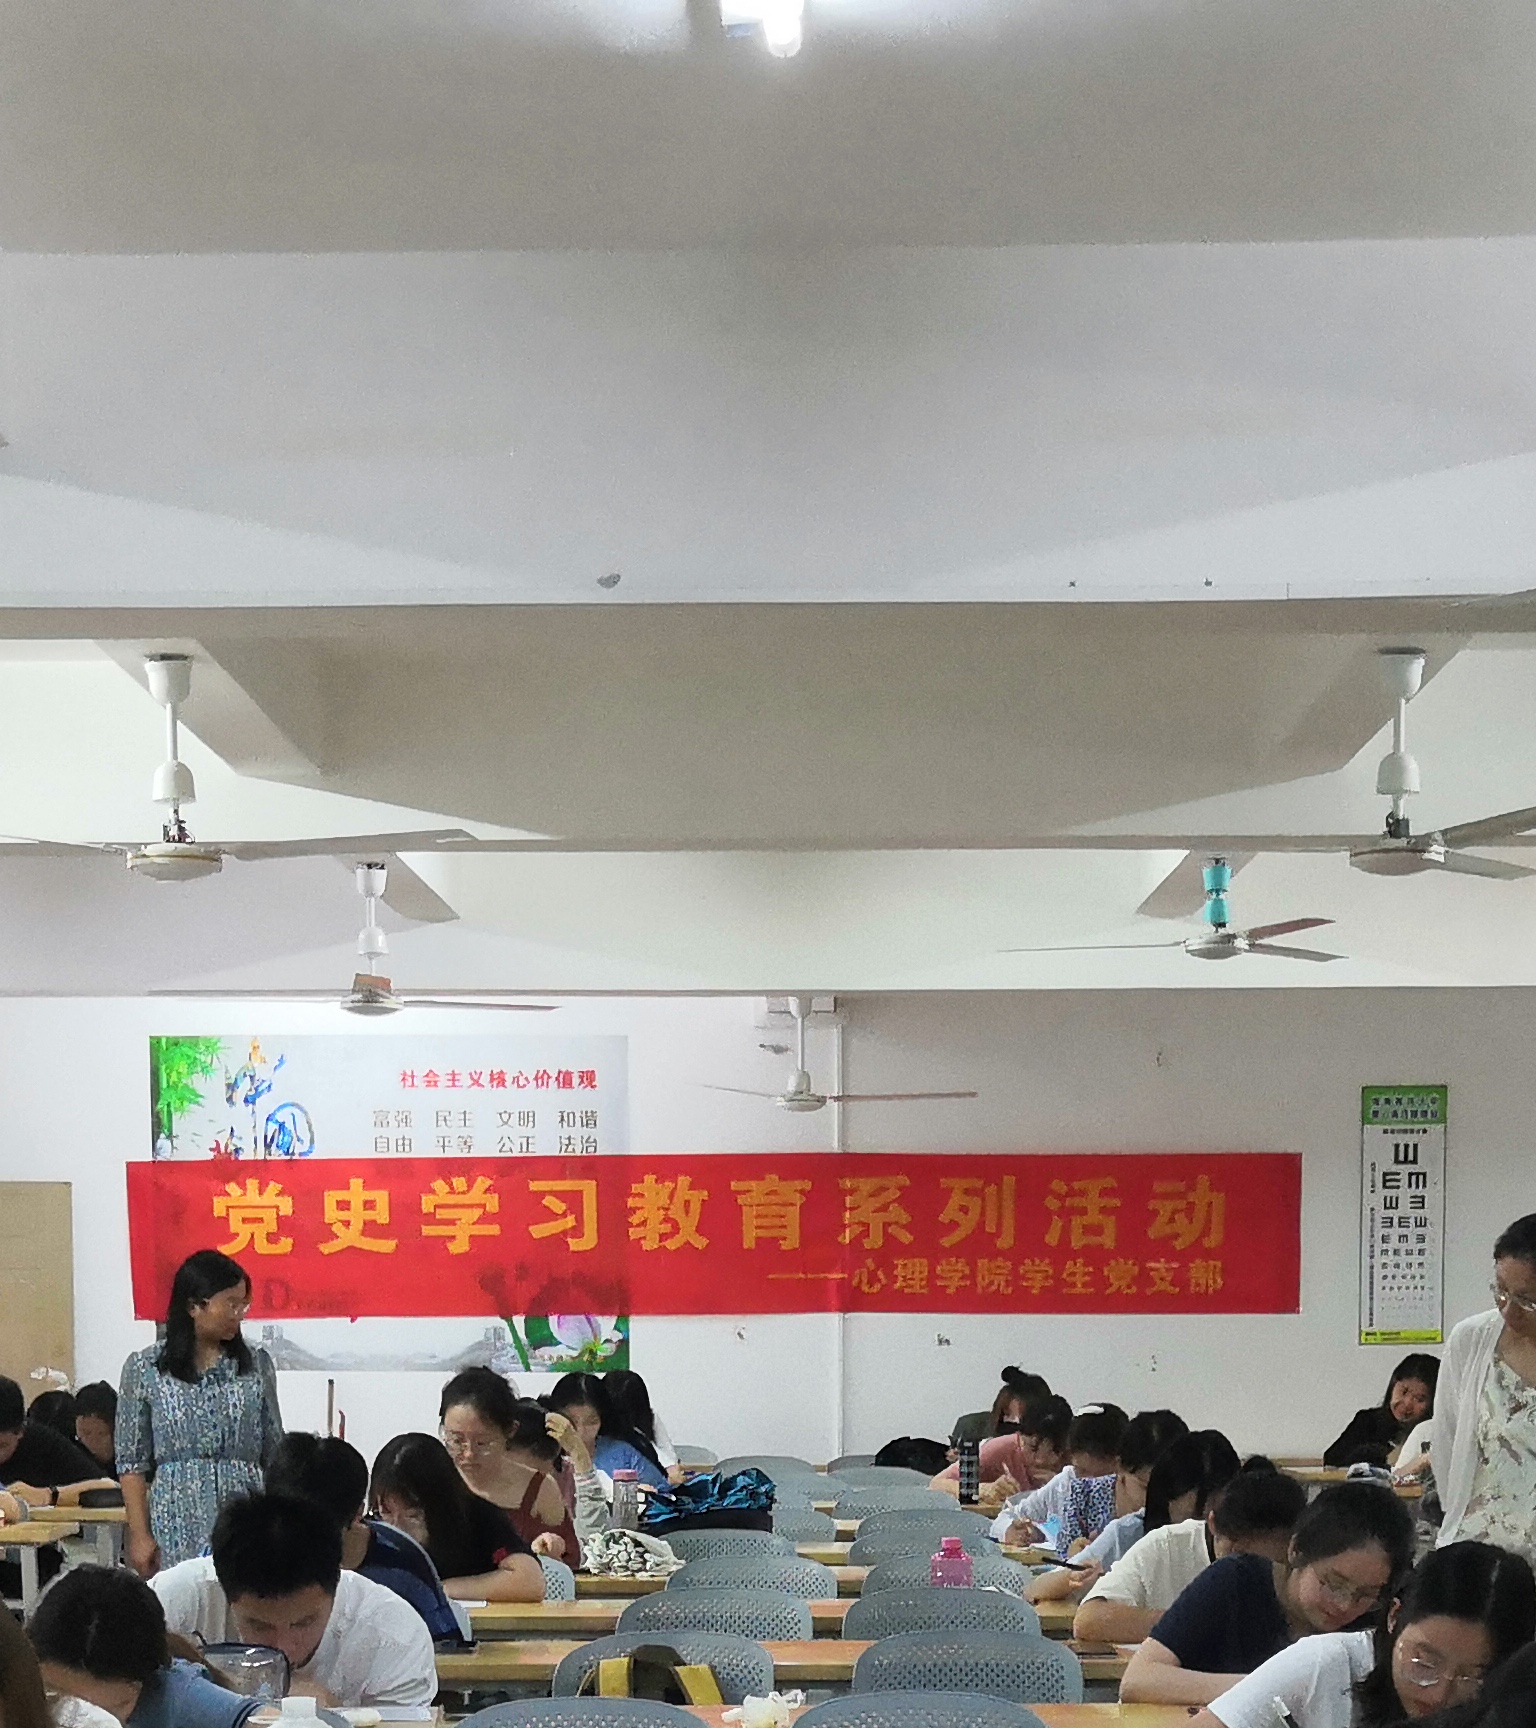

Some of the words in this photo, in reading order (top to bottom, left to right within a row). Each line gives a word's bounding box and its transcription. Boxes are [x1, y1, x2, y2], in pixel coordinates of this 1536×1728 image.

[399, 1068, 599, 1090] 社会主义核心价值观
[372, 1109, 413, 1129] 富强
[435, 1109, 475, 1129] 民主
[496, 1109, 537, 1129] 文明
[558, 1109, 599, 1129] 和谐
[373, 1134, 413, 1154] 自由
[434, 1134, 474, 1154] 平等
[496, 1134, 537, 1154] 公正
[558, 1134, 599, 1154] 法治
[212, 1174, 1226, 1256] 党史学习教育系列活动
